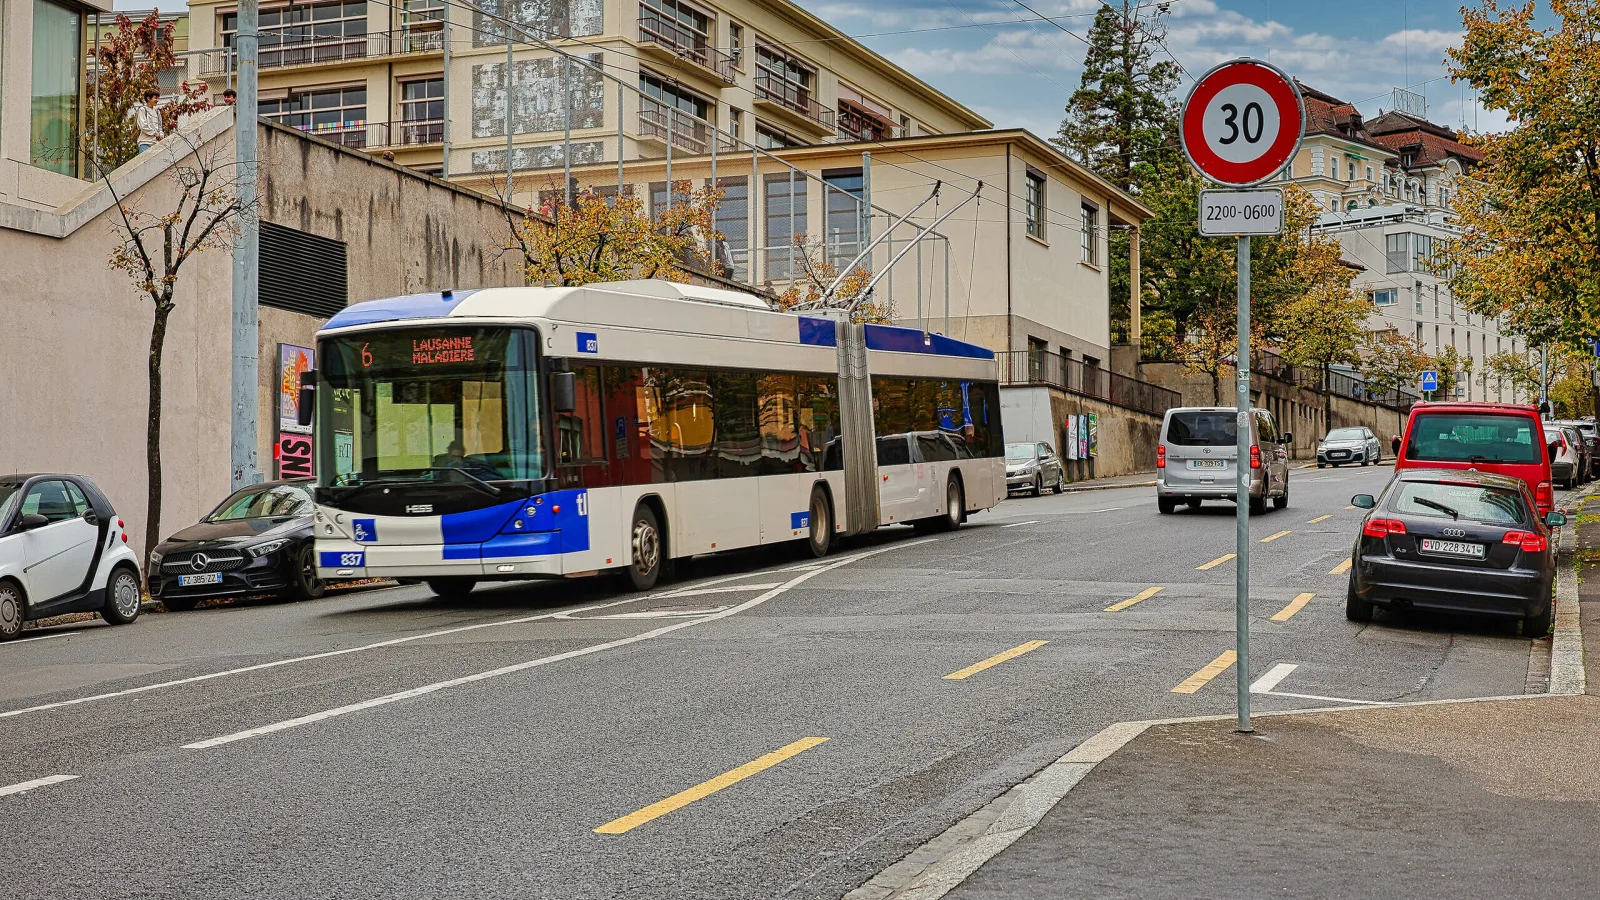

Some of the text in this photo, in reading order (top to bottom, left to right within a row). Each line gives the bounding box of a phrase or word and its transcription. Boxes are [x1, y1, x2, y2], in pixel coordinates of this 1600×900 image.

[1218, 102, 1264, 145] 30
[1206, 204, 1275, 221] 2200-0600
[412, 337, 473, 351] LAUSANNE
[586, 339, 597, 351] 837
[361, 342, 373, 367] 6
[412, 349, 475, 364] MALADIERE
[282, 358, 291, 417] FESTIVAL
[405, 504, 433, 514] HESS
[576, 492, 587, 516] tl
[340, 553, 363, 566] 837
